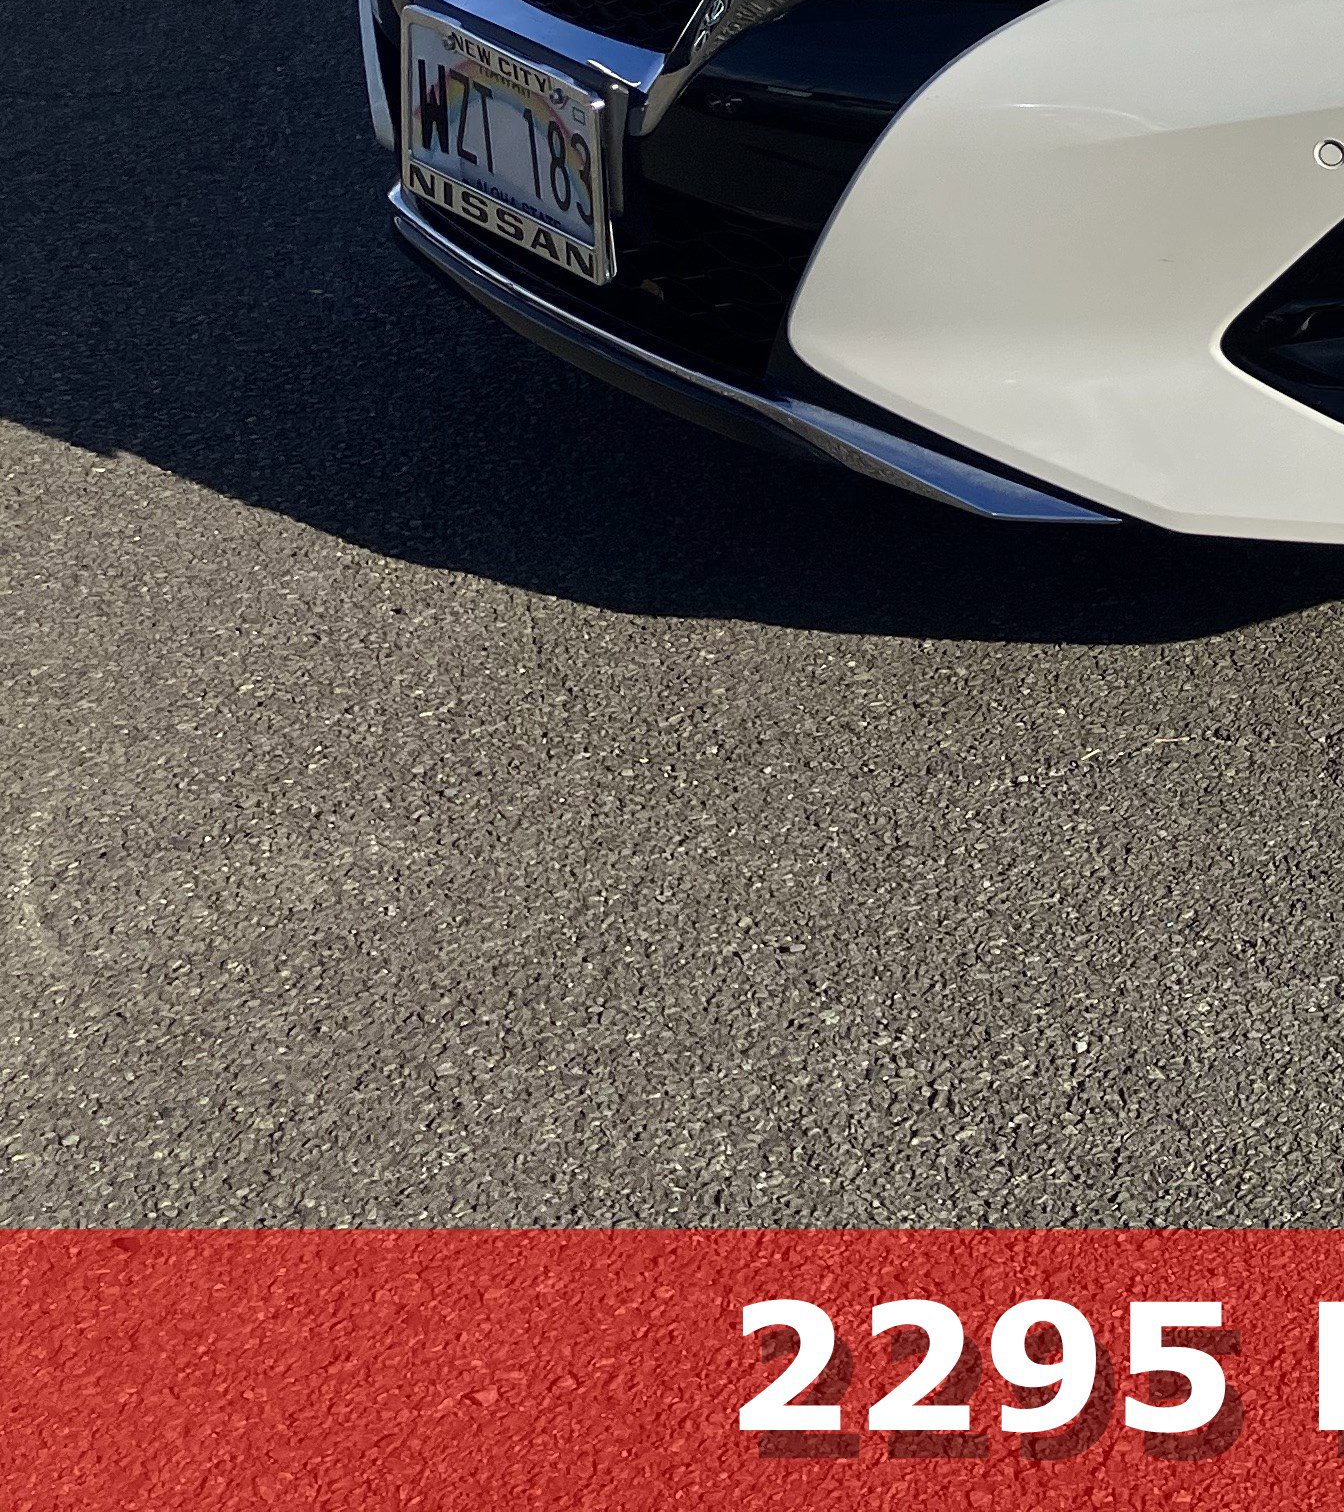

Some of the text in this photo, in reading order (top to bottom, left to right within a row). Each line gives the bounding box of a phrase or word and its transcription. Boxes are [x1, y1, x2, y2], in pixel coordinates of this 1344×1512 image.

[451, 31, 491, 66] NEW
[498, 56, 549, 93] CITY
[418, 59, 595, 228] WZT 183
[409, 162, 595, 279] NISSAN
